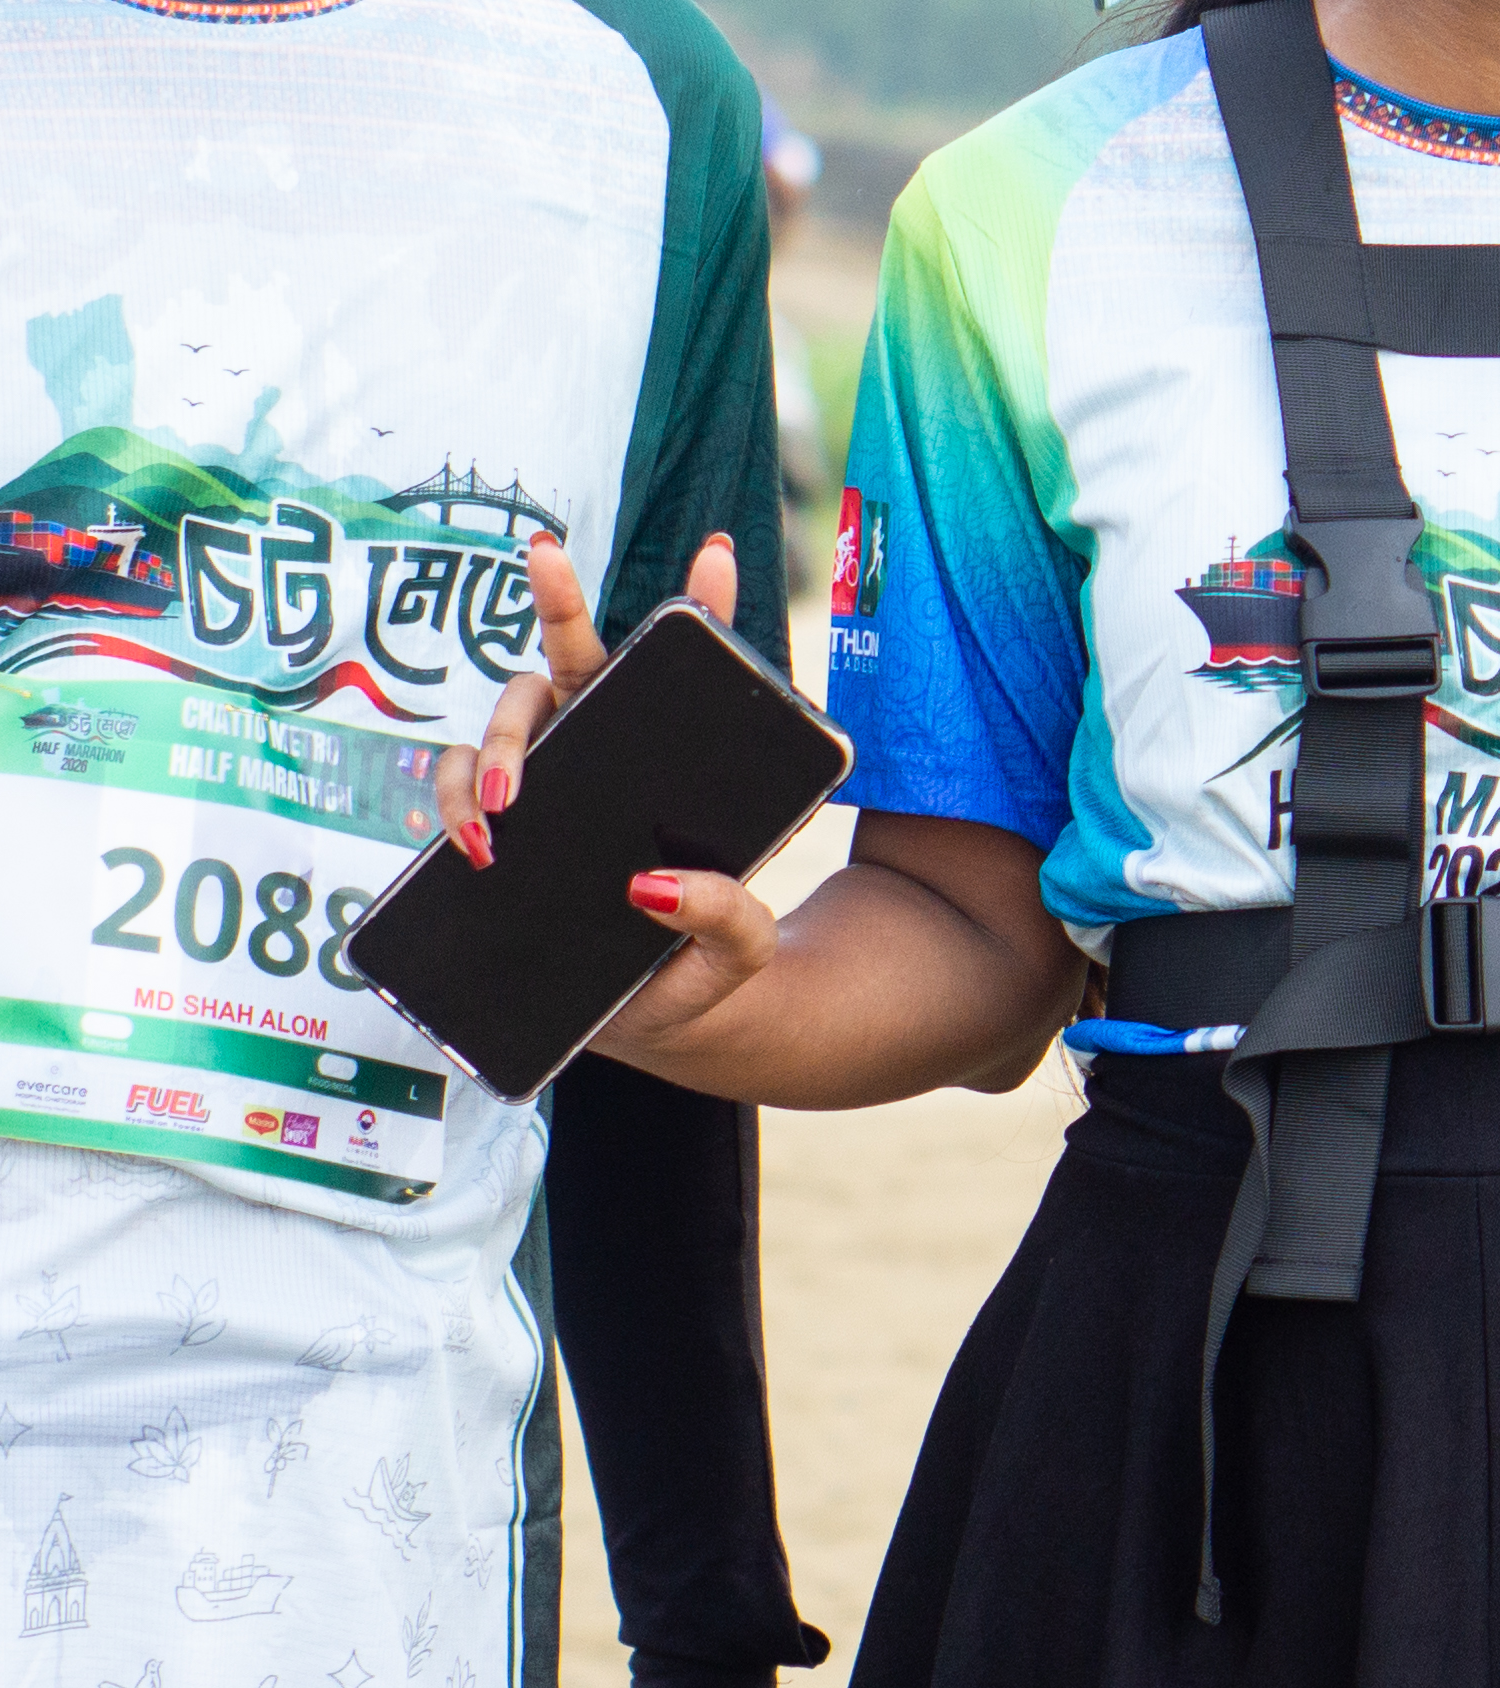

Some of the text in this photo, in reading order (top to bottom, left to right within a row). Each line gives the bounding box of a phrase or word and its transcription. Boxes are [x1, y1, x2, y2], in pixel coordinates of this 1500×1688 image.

[182, 696, 341, 766] CHATTO METRO
[32, 741, 126, 764] HALF MARATHON
[60, 757, 88, 773] 2026
[169, 743, 353, 816] HALF MARATHON
[91, 846, 378, 992] 2088
[134, 987, 329, 1042] MD SHAH ALOM
[16, 1079, 89, 1098] evercare
[126, 1084, 211, 1124] FUEL
[408, 1084, 419, 1101] L
